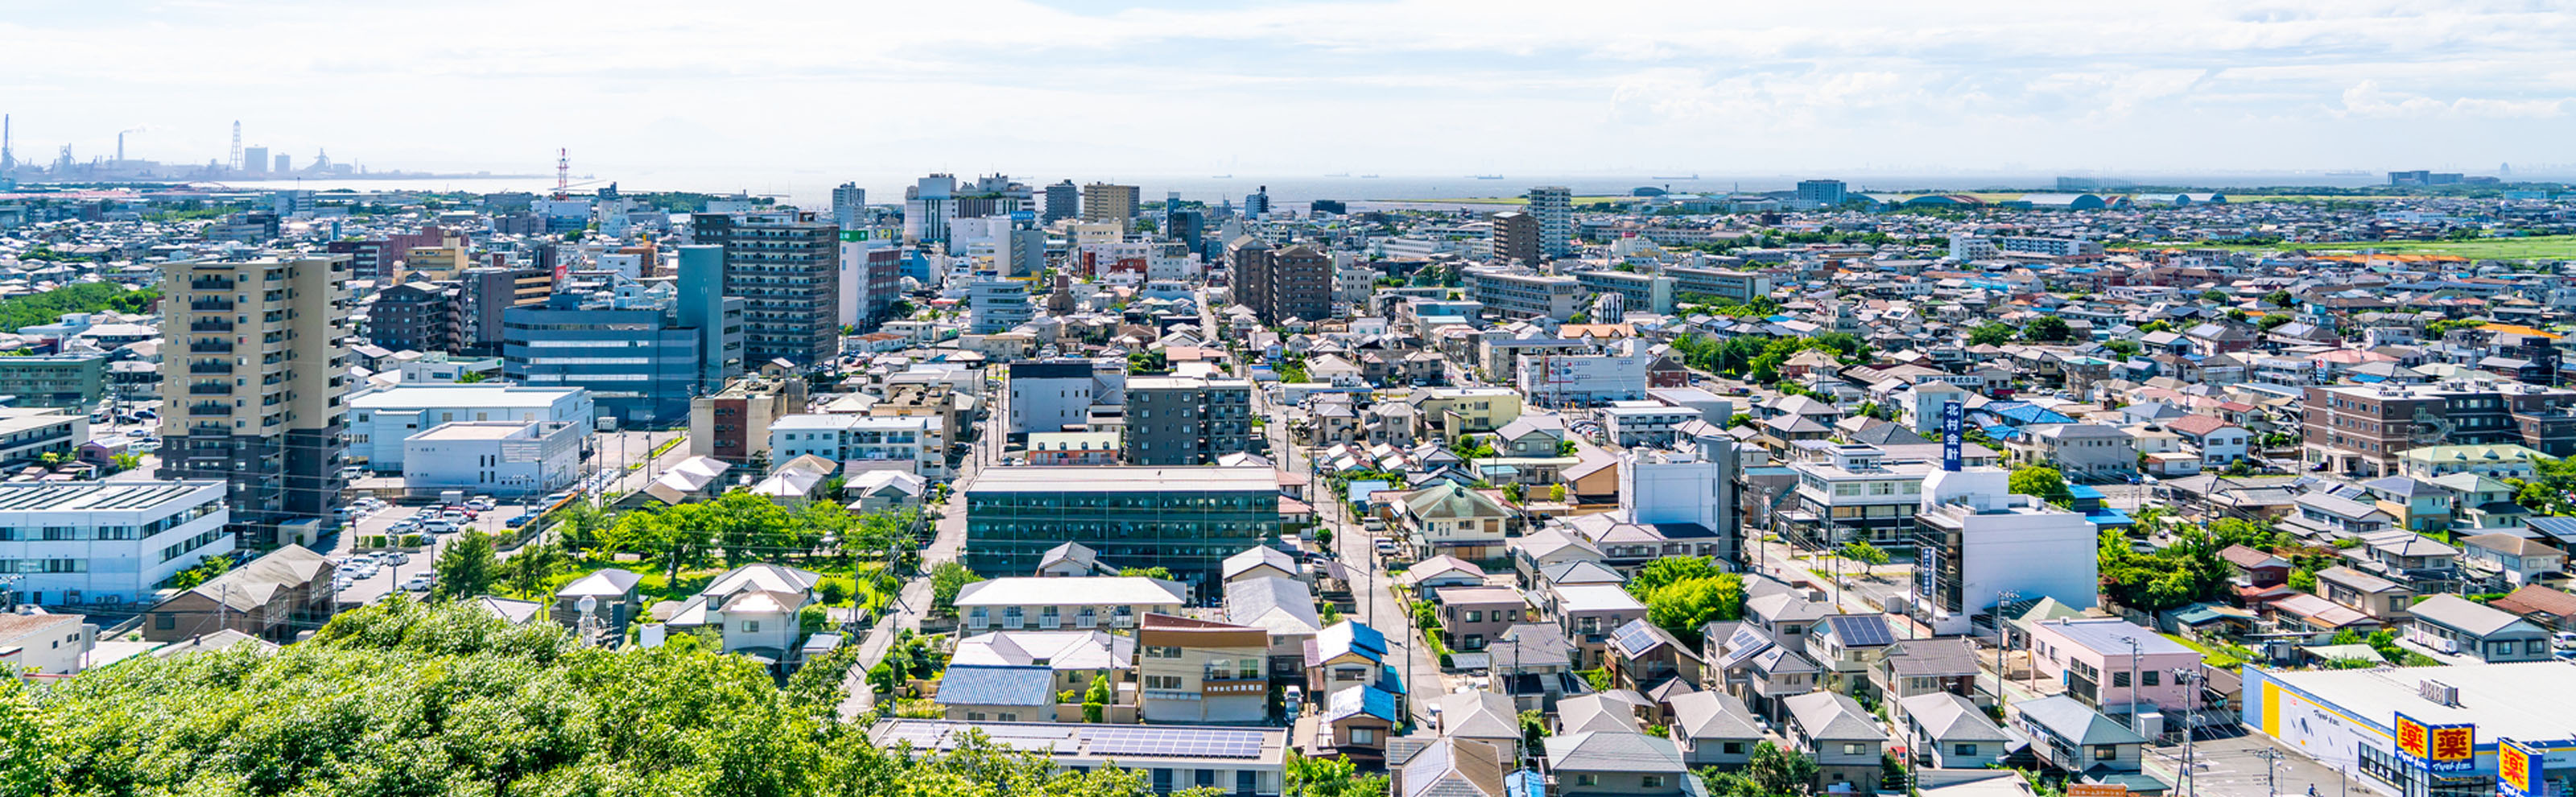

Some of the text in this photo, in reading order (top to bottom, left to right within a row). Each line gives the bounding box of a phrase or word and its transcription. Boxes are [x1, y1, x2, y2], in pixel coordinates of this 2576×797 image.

[1946, 403, 1959, 460] 北村会計
[2401, 721, 2424, 755] 薬
[2437, 729, 2467, 758] 薬
[2503, 746, 2525, 787] 薬
